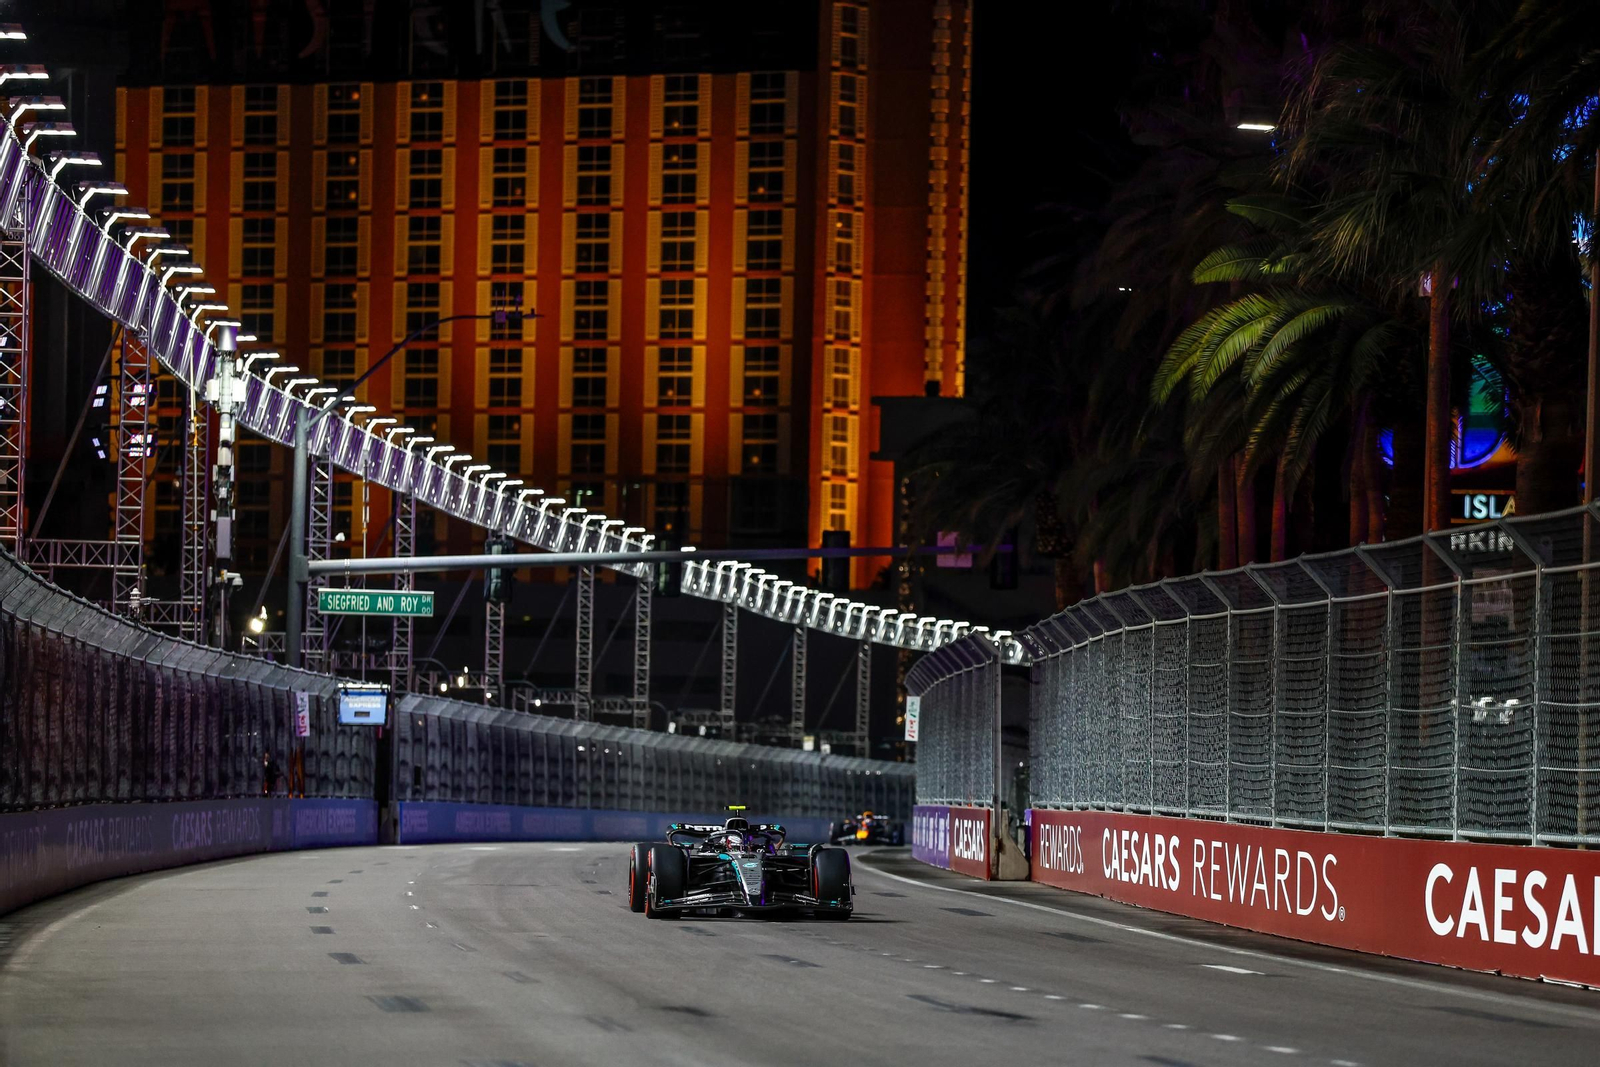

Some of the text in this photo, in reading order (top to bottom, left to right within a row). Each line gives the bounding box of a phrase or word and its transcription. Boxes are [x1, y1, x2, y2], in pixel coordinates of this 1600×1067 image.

[327, 594, 370, 611] SIEGFRIED
[376, 596, 394, 612] AND
[400, 596, 419, 612] ROY
[421, 595, 431, 603] DR
[66, 815, 152, 870] CAESARS REWARDS
[172, 811, 213, 851] CAESARS
[216, 806, 260, 844] REWARDS
[954, 818, 985, 862] CAESARS
[1039, 823, 1083, 875] REWARDS
[1102, 827, 1181, 892] CAESARS
[1424, 862, 1600, 957] CAESA
